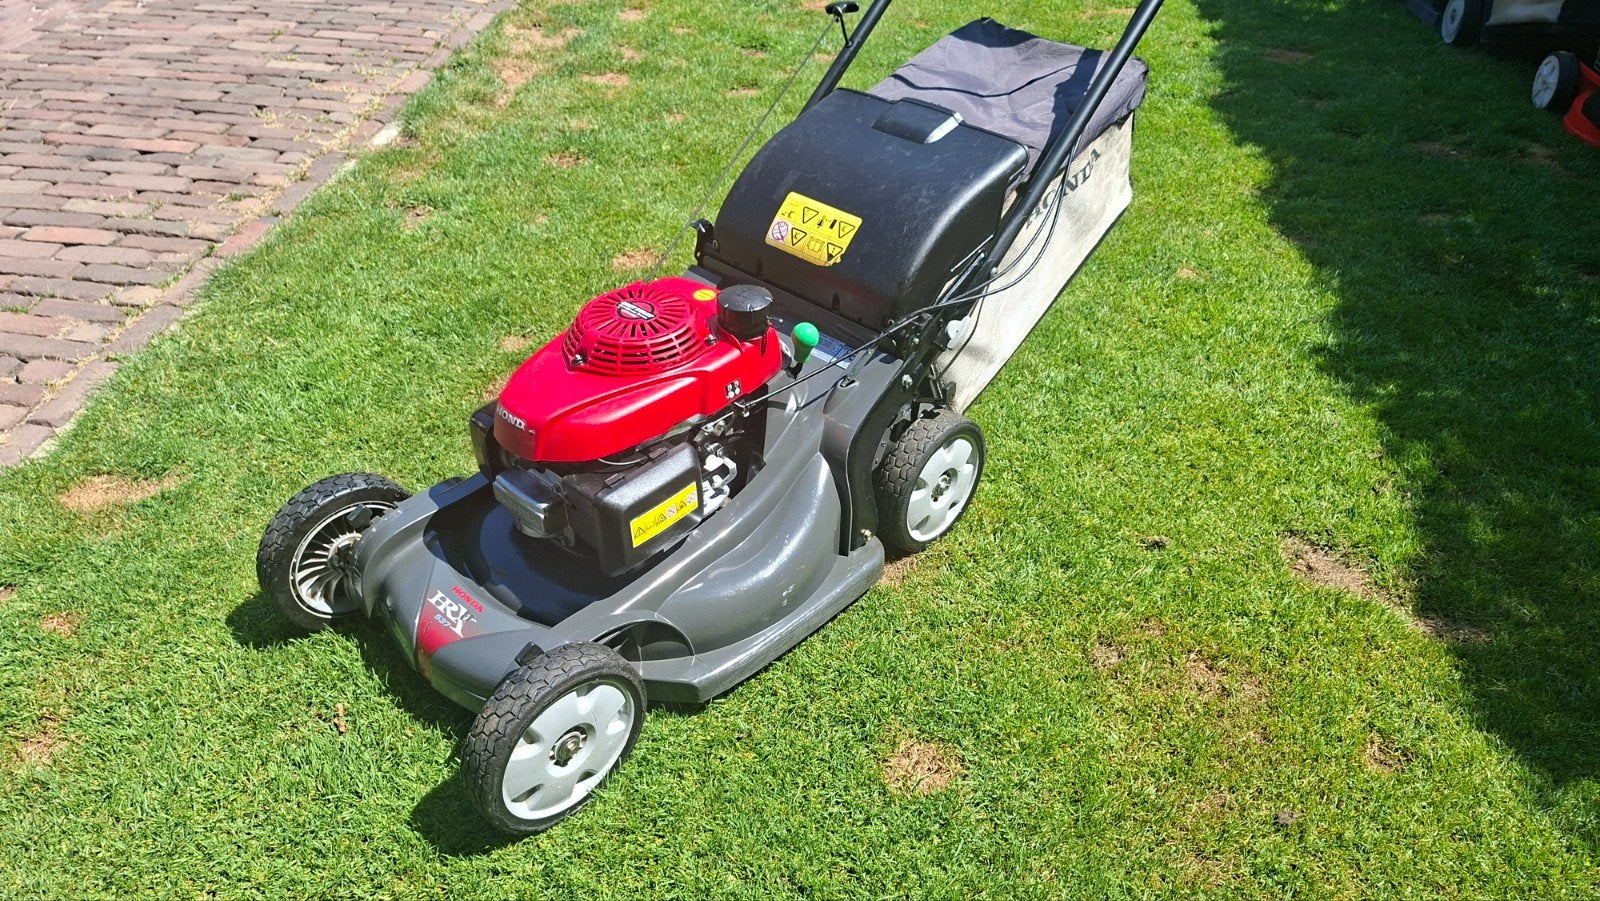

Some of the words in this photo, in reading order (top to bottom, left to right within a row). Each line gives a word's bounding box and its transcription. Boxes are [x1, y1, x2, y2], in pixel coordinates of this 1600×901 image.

[427, 590, 478, 638] HRX
[451, 585, 484, 614] HONDA
[434, 613, 451, 627] 537
